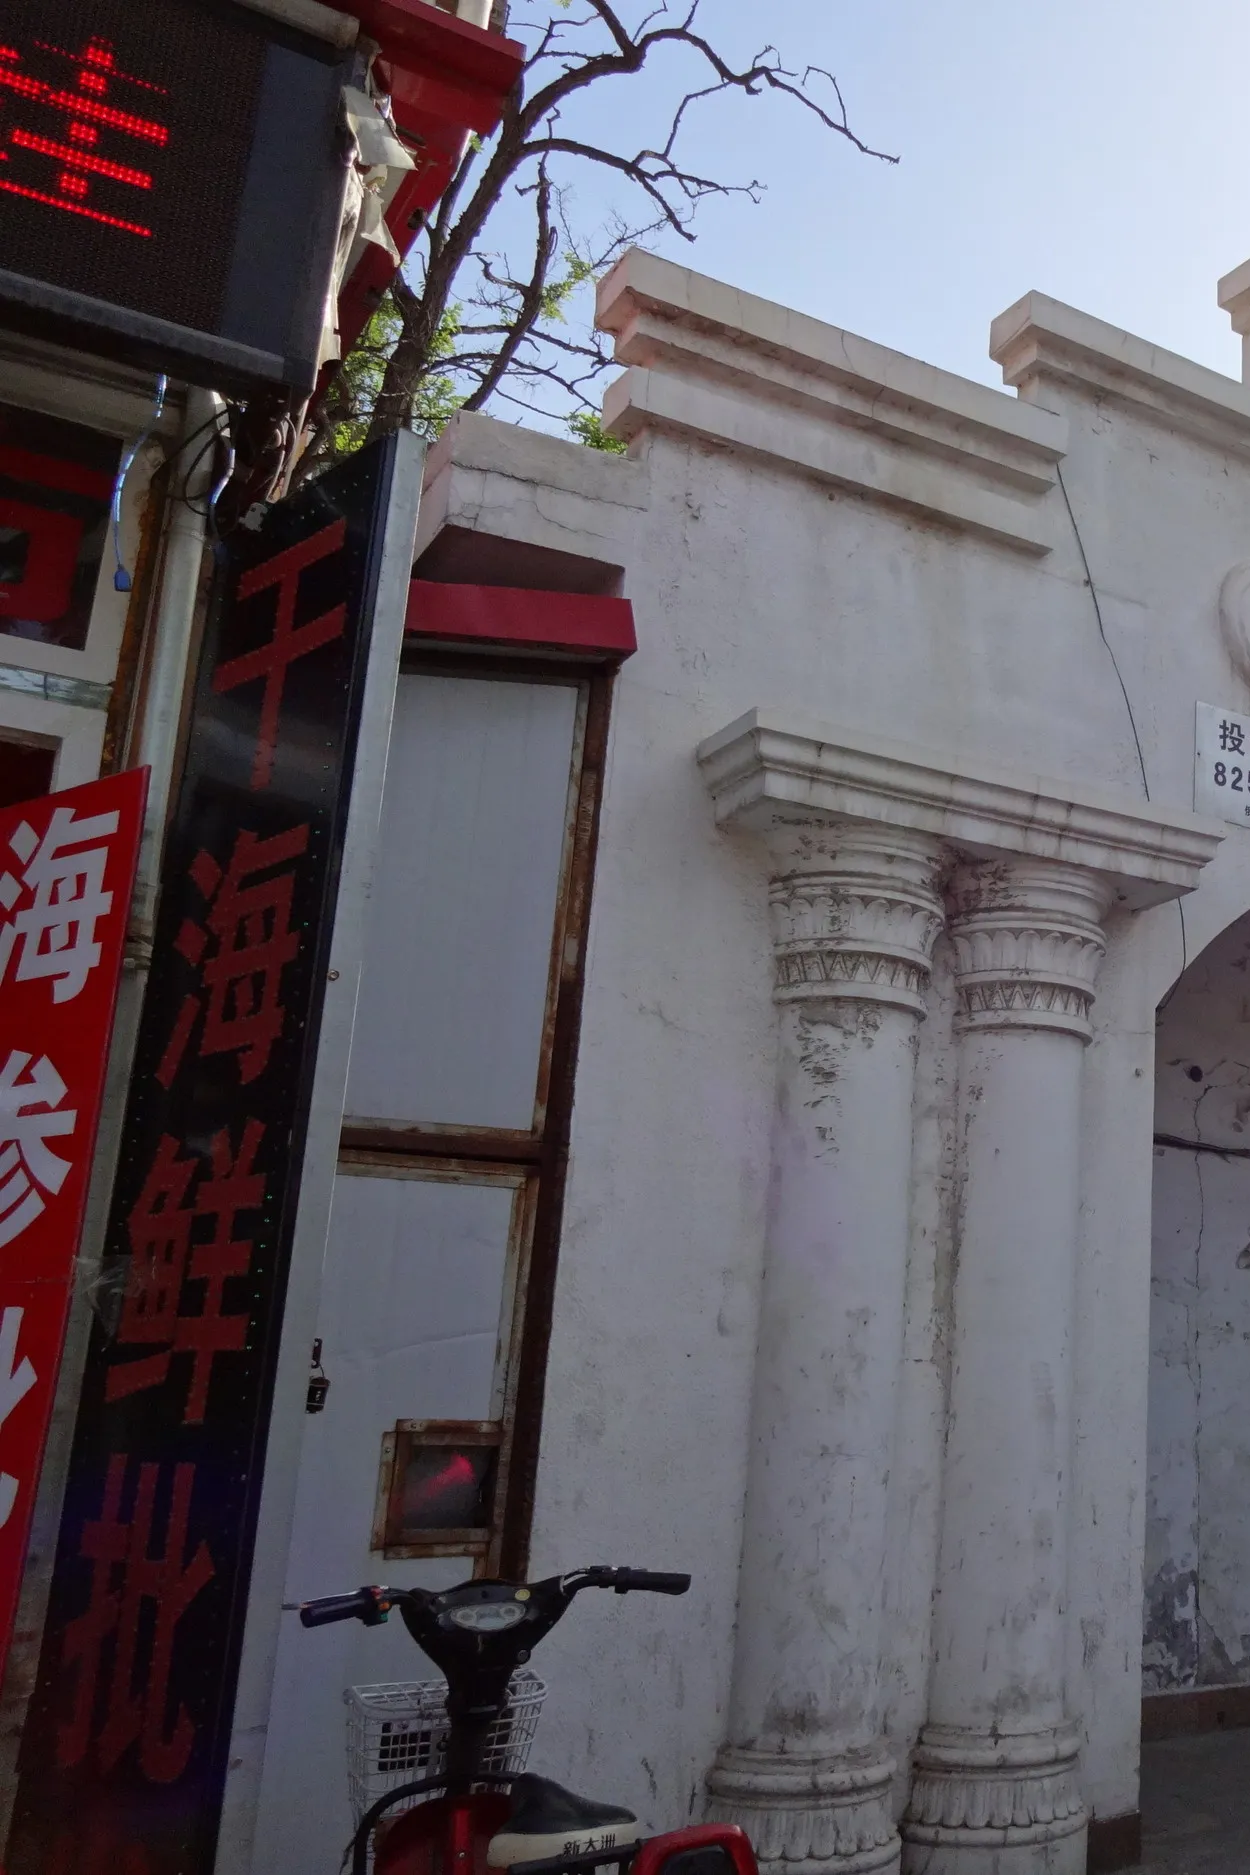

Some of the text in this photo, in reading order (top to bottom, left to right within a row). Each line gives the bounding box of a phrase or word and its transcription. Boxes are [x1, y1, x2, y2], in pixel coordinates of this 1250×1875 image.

[56, 517, 347, 1875] 干海鲜批
[562, 1832, 617, 1857] 新大洲
